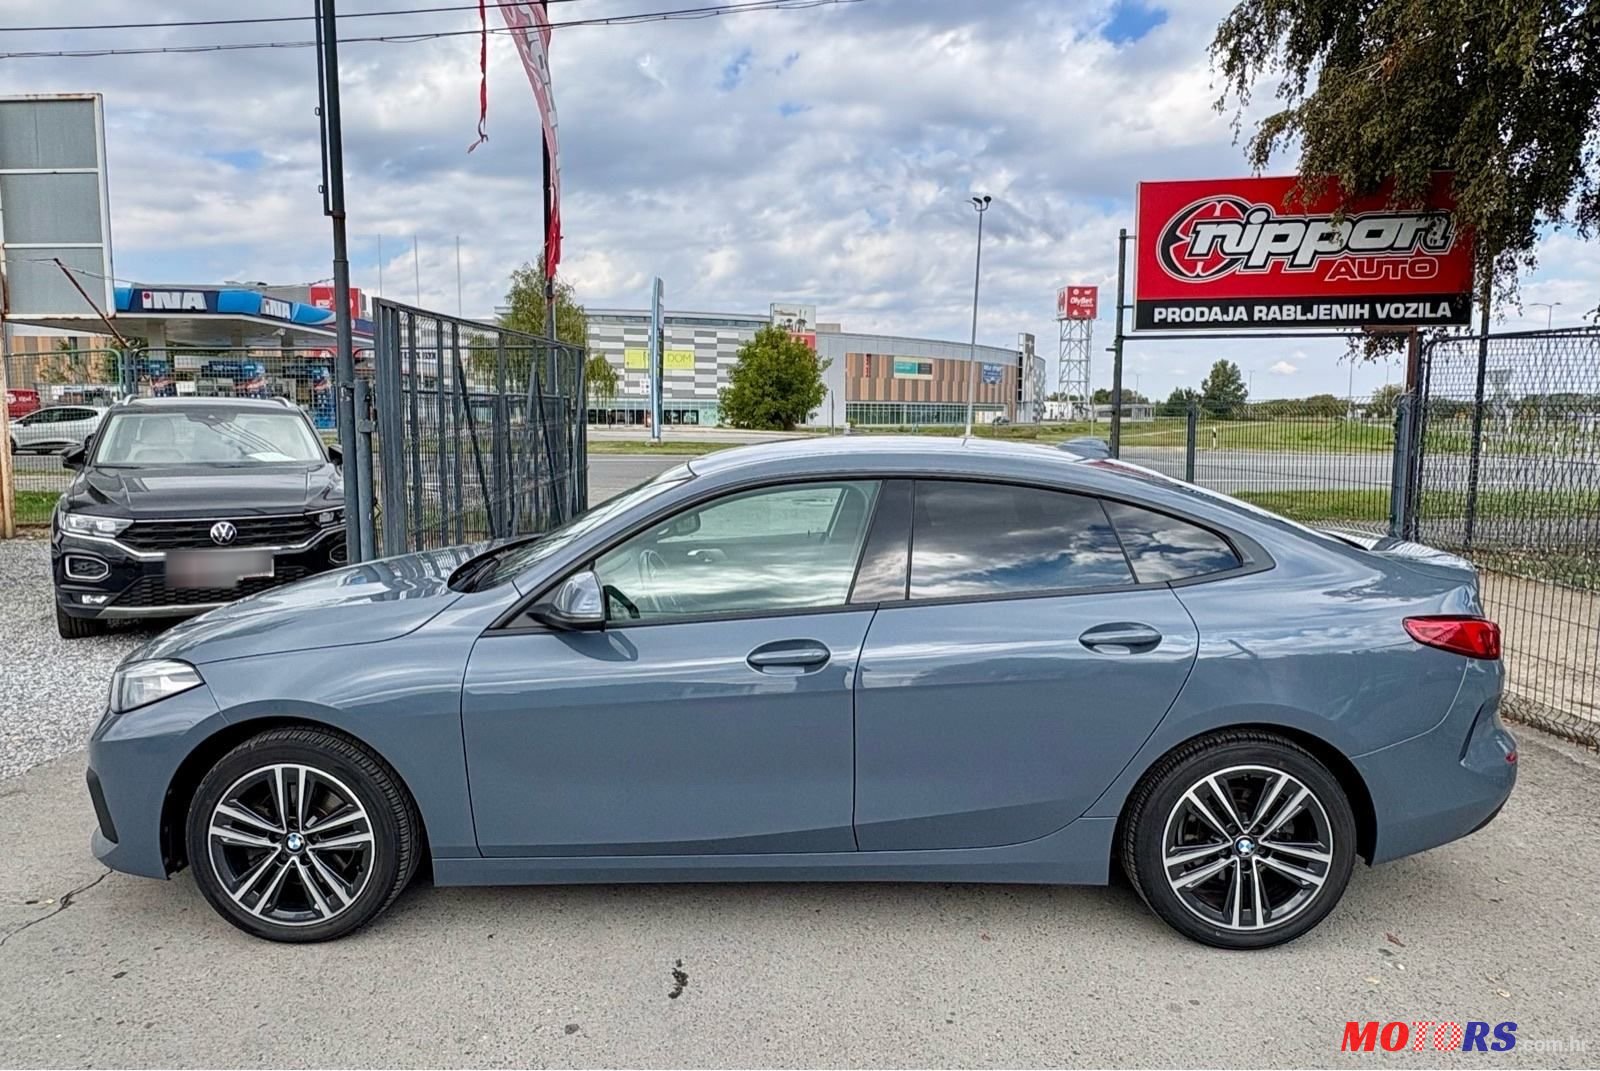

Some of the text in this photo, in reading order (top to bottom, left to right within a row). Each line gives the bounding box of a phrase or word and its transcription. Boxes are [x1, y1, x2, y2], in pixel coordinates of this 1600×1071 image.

[1324, 257, 1439, 281] AUTO
[1153, 301, 1452, 324] PRODAJA RABLJENIH VOZILA
